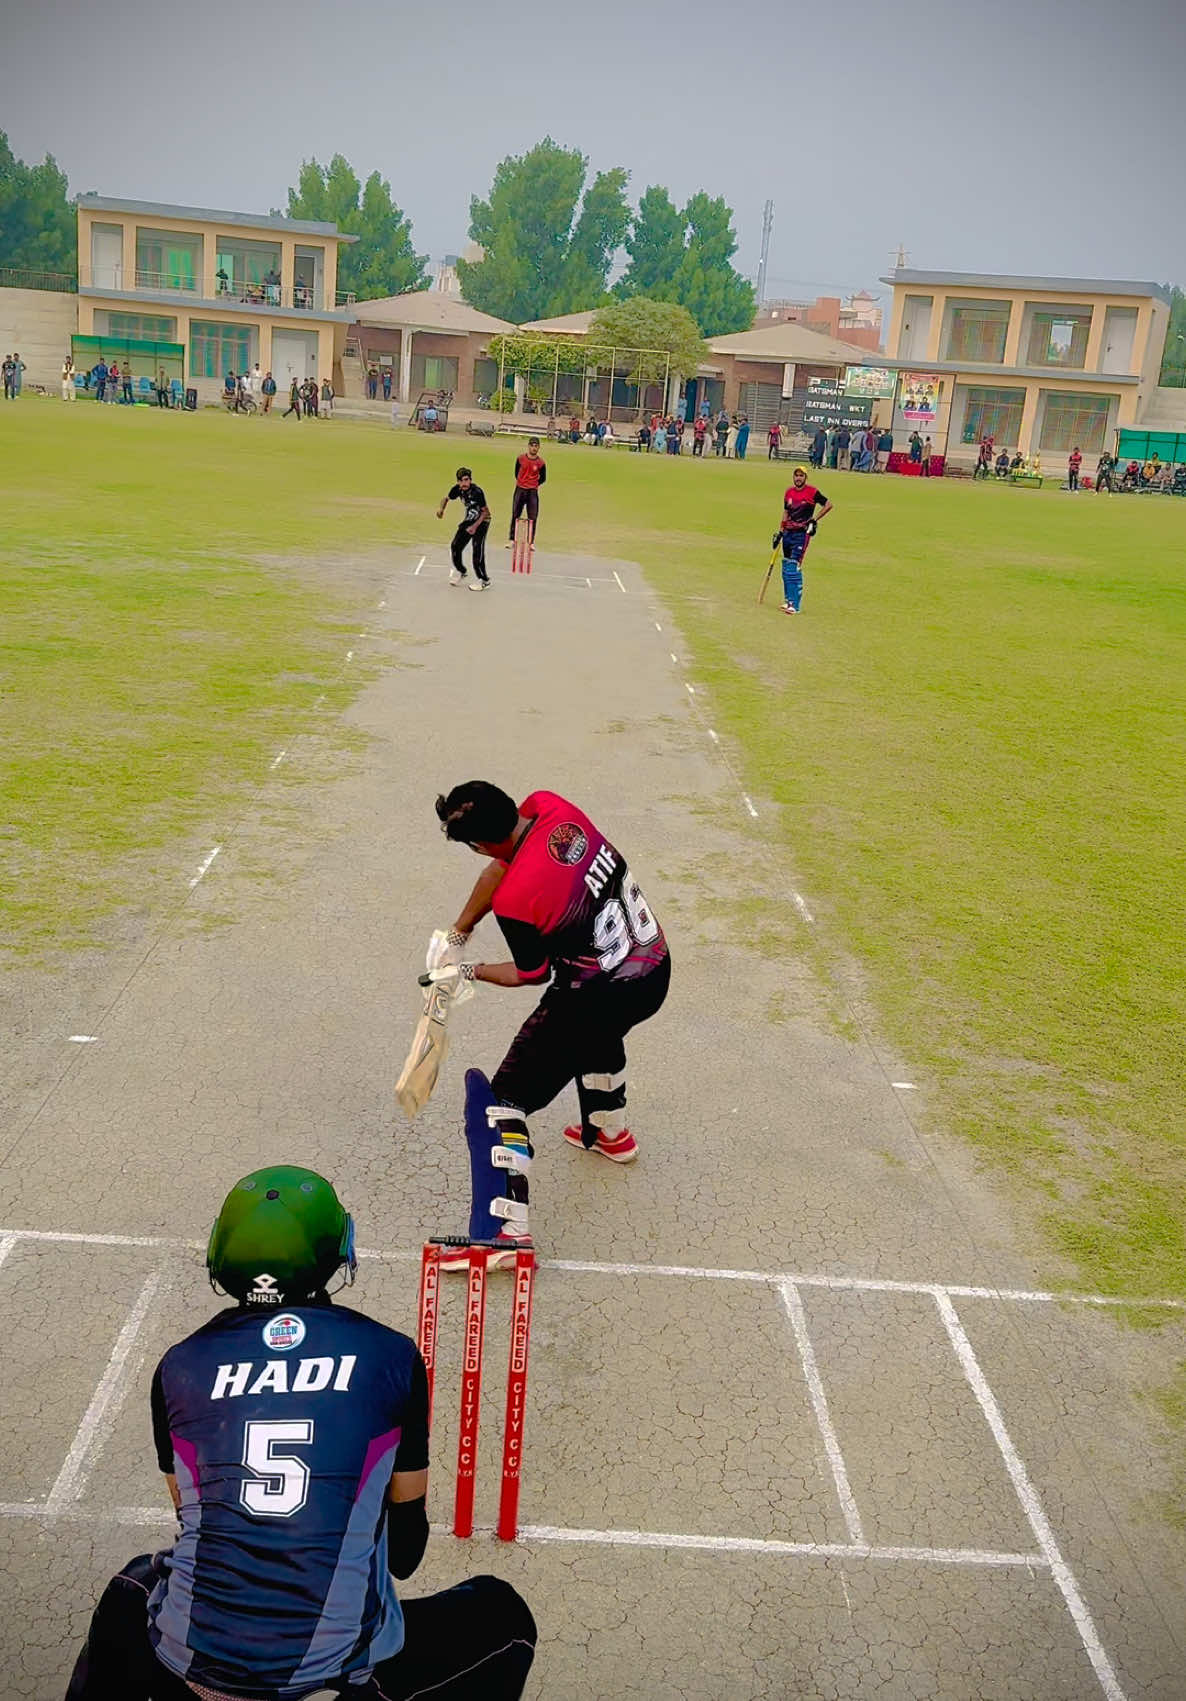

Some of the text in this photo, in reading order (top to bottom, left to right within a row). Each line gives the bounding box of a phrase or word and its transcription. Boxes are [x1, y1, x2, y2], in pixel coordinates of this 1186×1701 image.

[806, 400, 865, 413] BATSMAN WKT
[808, 387, 843, 396] BATSMAN
[804, 414, 825, 423] LAST
[842, 419, 869, 428] OVERS
[584, 843, 617, 899] ATIF
[593, 869, 660, 972] 96
[246, 1292, 286, 1304] SHREY
[471, 1270, 481, 1292] AL
[519, 1270, 528, 1293] AL
[270, 1326, 298, 1336] GREEN
[422, 1266, 436, 1366] AL FAREED
[467, 1301, 480, 1369] FAREED
[514, 1302, 526, 1370] FAREED
[210, 1354, 357, 1400] HADI
[465, 1378, 474, 1429] CITY
[512, 1382, 522, 1432] CITY
[239, 1418, 314, 1518] 5
